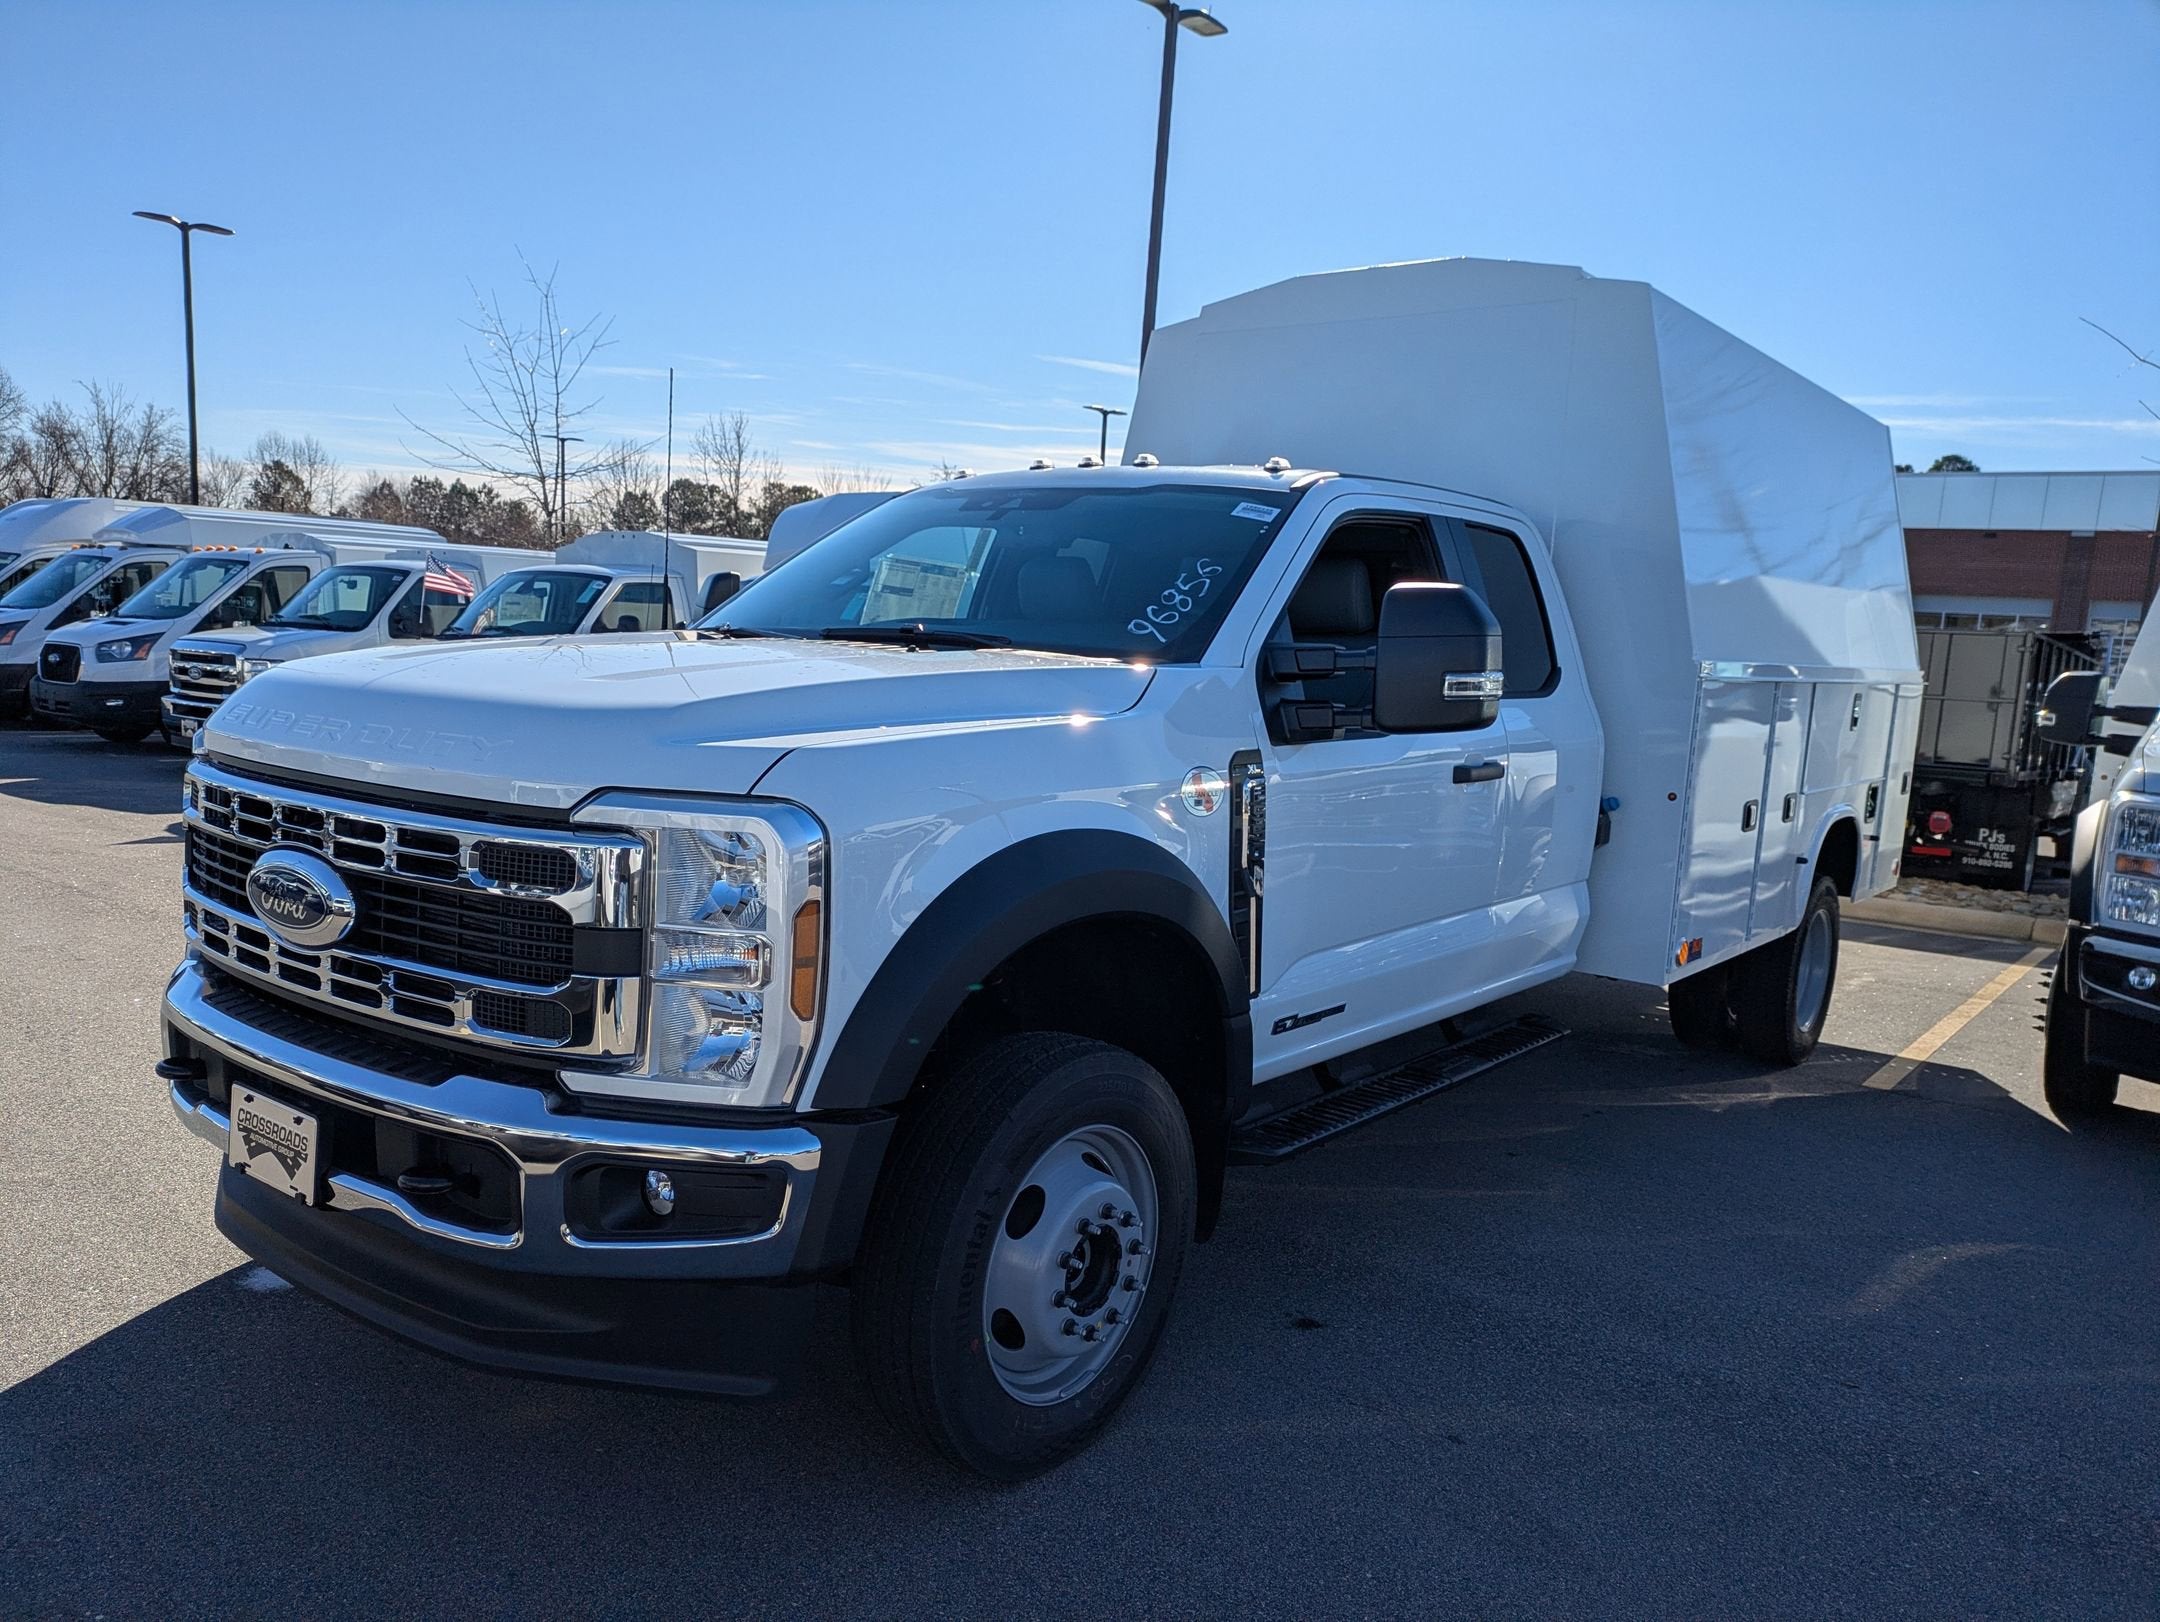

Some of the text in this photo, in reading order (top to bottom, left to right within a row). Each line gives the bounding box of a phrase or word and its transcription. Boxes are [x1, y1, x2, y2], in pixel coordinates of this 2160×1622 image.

[1127, 558, 1222, 643] 96856
[222, 703, 351, 744] SUPER
[360, 723, 515, 762] DUTY
[259, 874, 310, 920] Ford
[237, 1108, 309, 1152] CROSSROADS
[249, 1132, 295, 1158] AUTOMOTIVE GROUP
